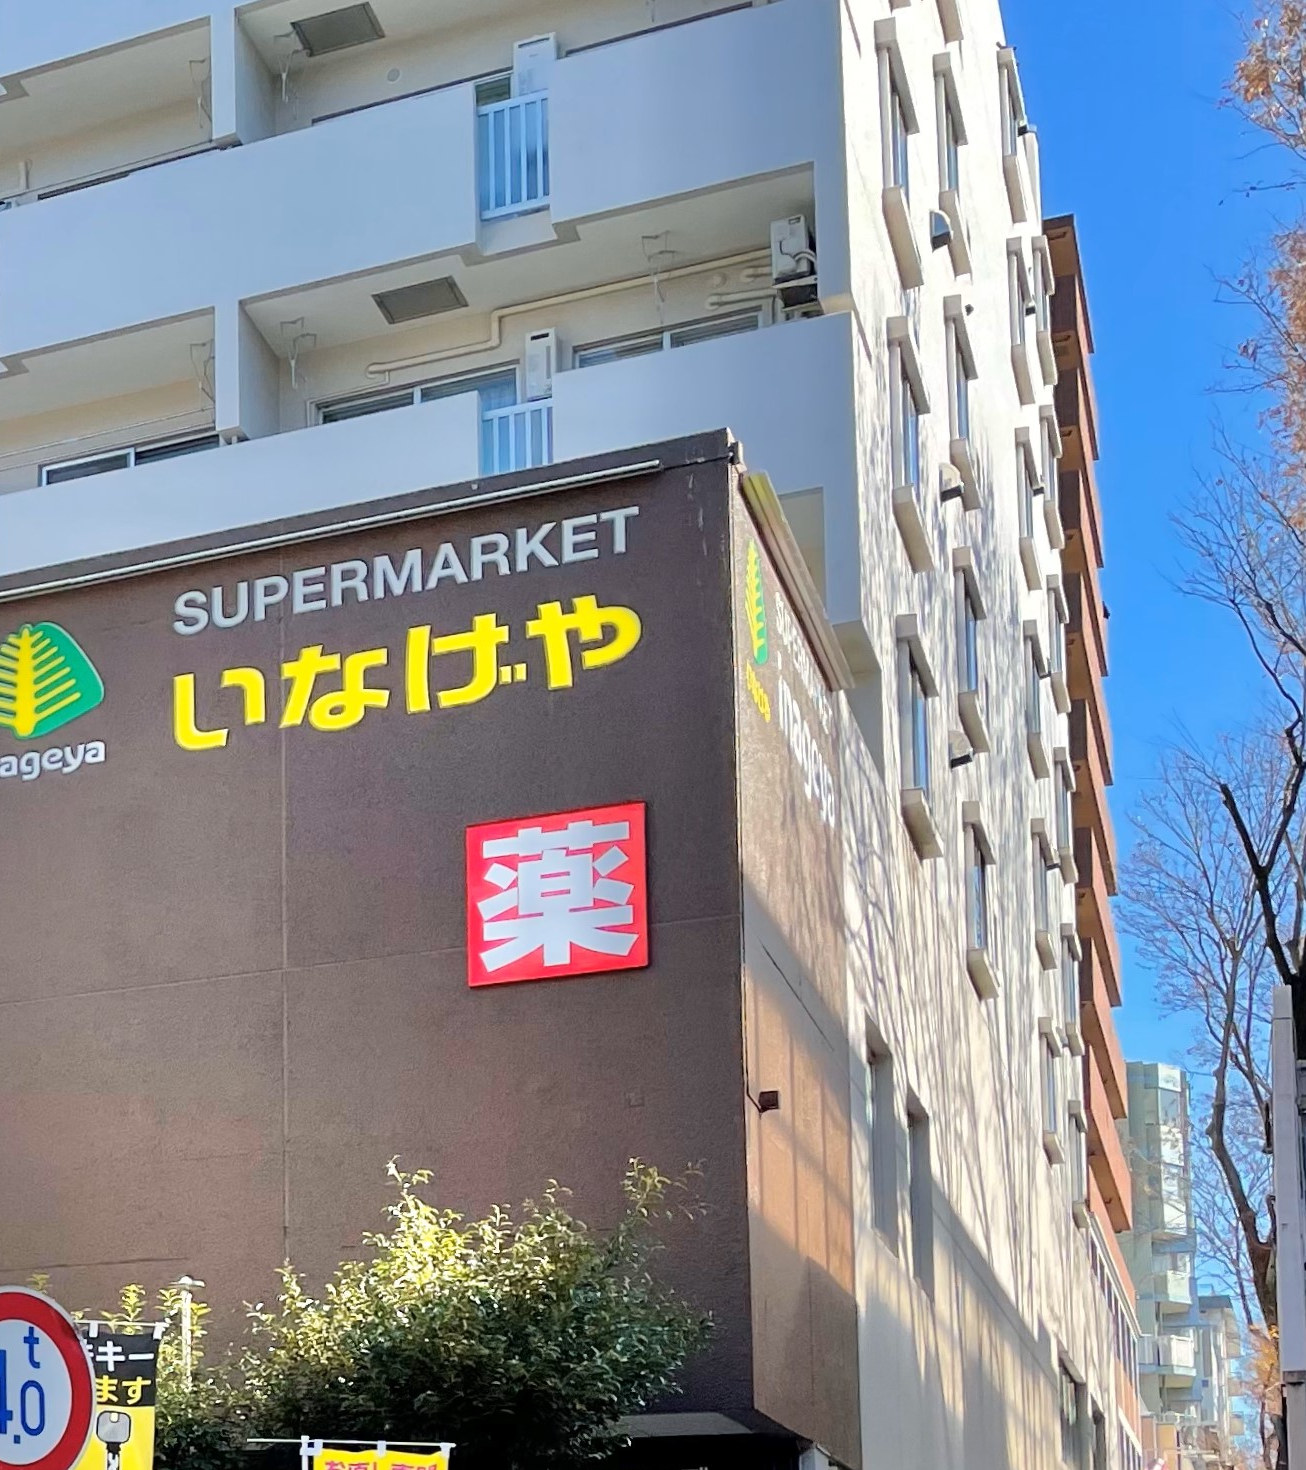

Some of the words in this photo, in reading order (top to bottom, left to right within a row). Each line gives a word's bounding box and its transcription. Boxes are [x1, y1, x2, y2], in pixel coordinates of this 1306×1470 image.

[173, 506, 640, 637] SUPERMARKET
[171, 594, 643, 751] いなげや
[476, 819, 637, 973] 薬
[85, 1339, 155, 1372] キー
